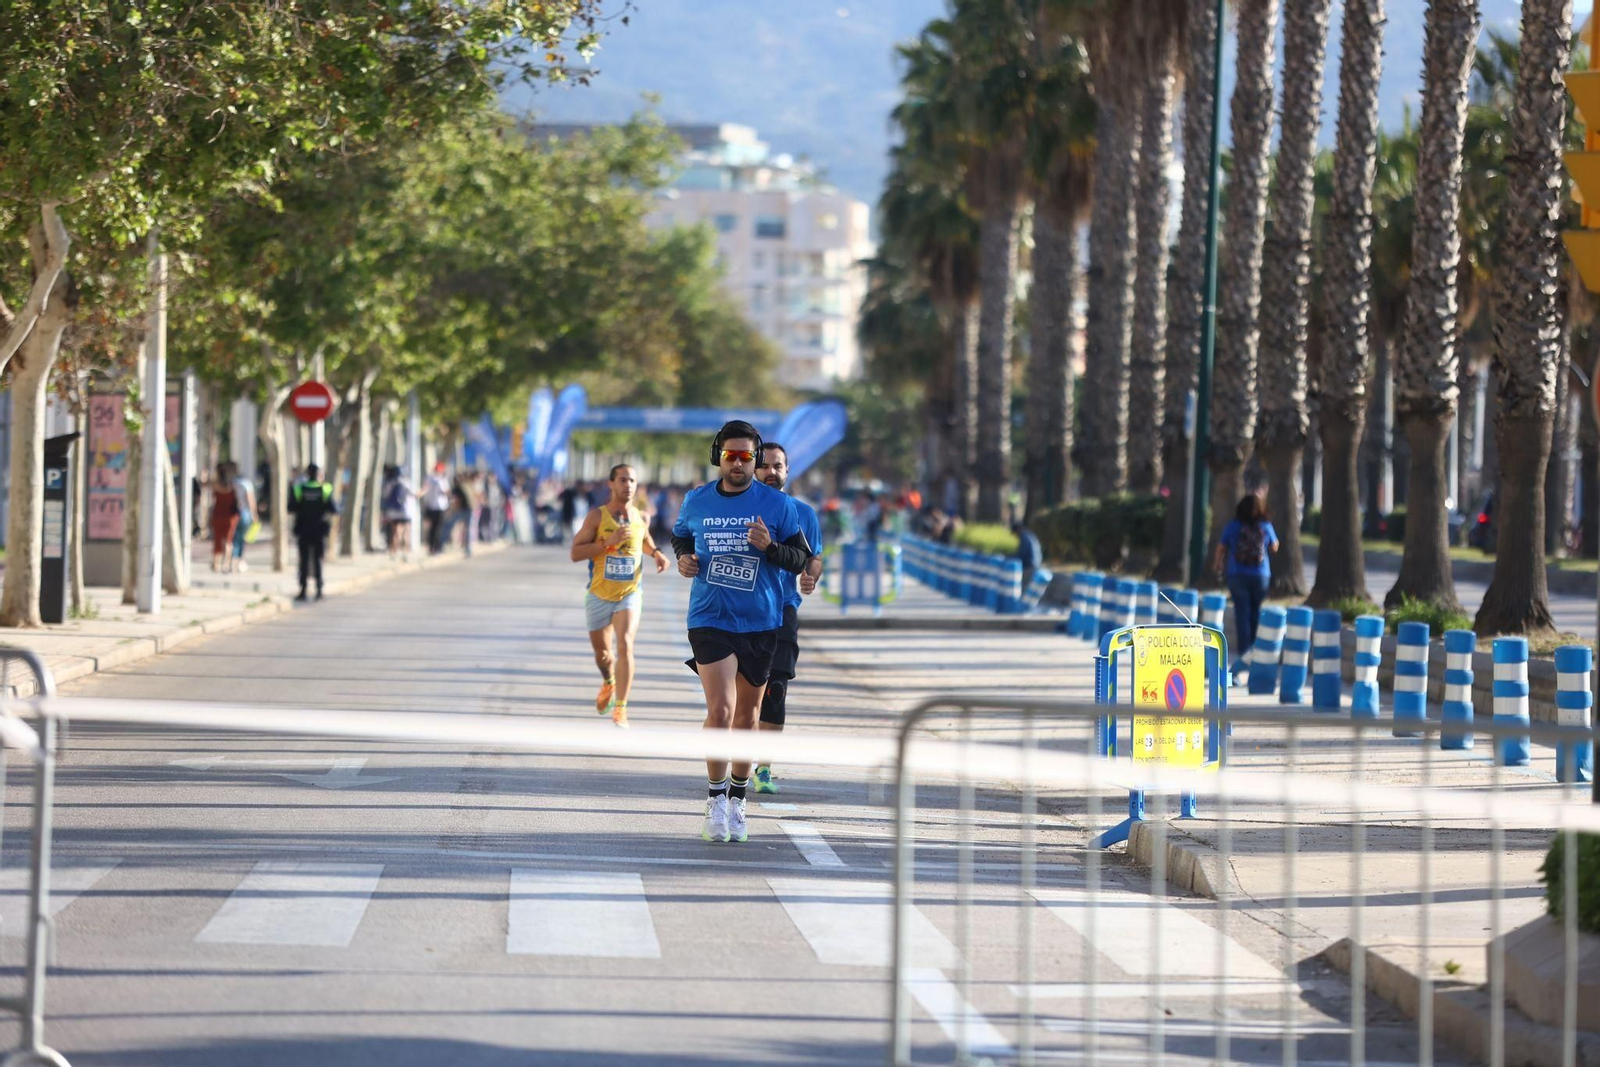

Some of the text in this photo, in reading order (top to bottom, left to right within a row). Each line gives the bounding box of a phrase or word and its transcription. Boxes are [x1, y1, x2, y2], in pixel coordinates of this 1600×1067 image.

[47, 468, 61, 486] P
[703, 515, 755, 528] mayoral
[714, 563, 751, 579] 2056
[1148, 634, 1203, 648] POLICÍA LOCAL
[1159, 651, 1192, 666] MÁLAGA
[1136, 717, 1202, 726] PROHIBIDO ESTACIONAR DESDE
[1136, 737, 1144, 745] LAS
[1159, 737, 1167, 745] DEL
